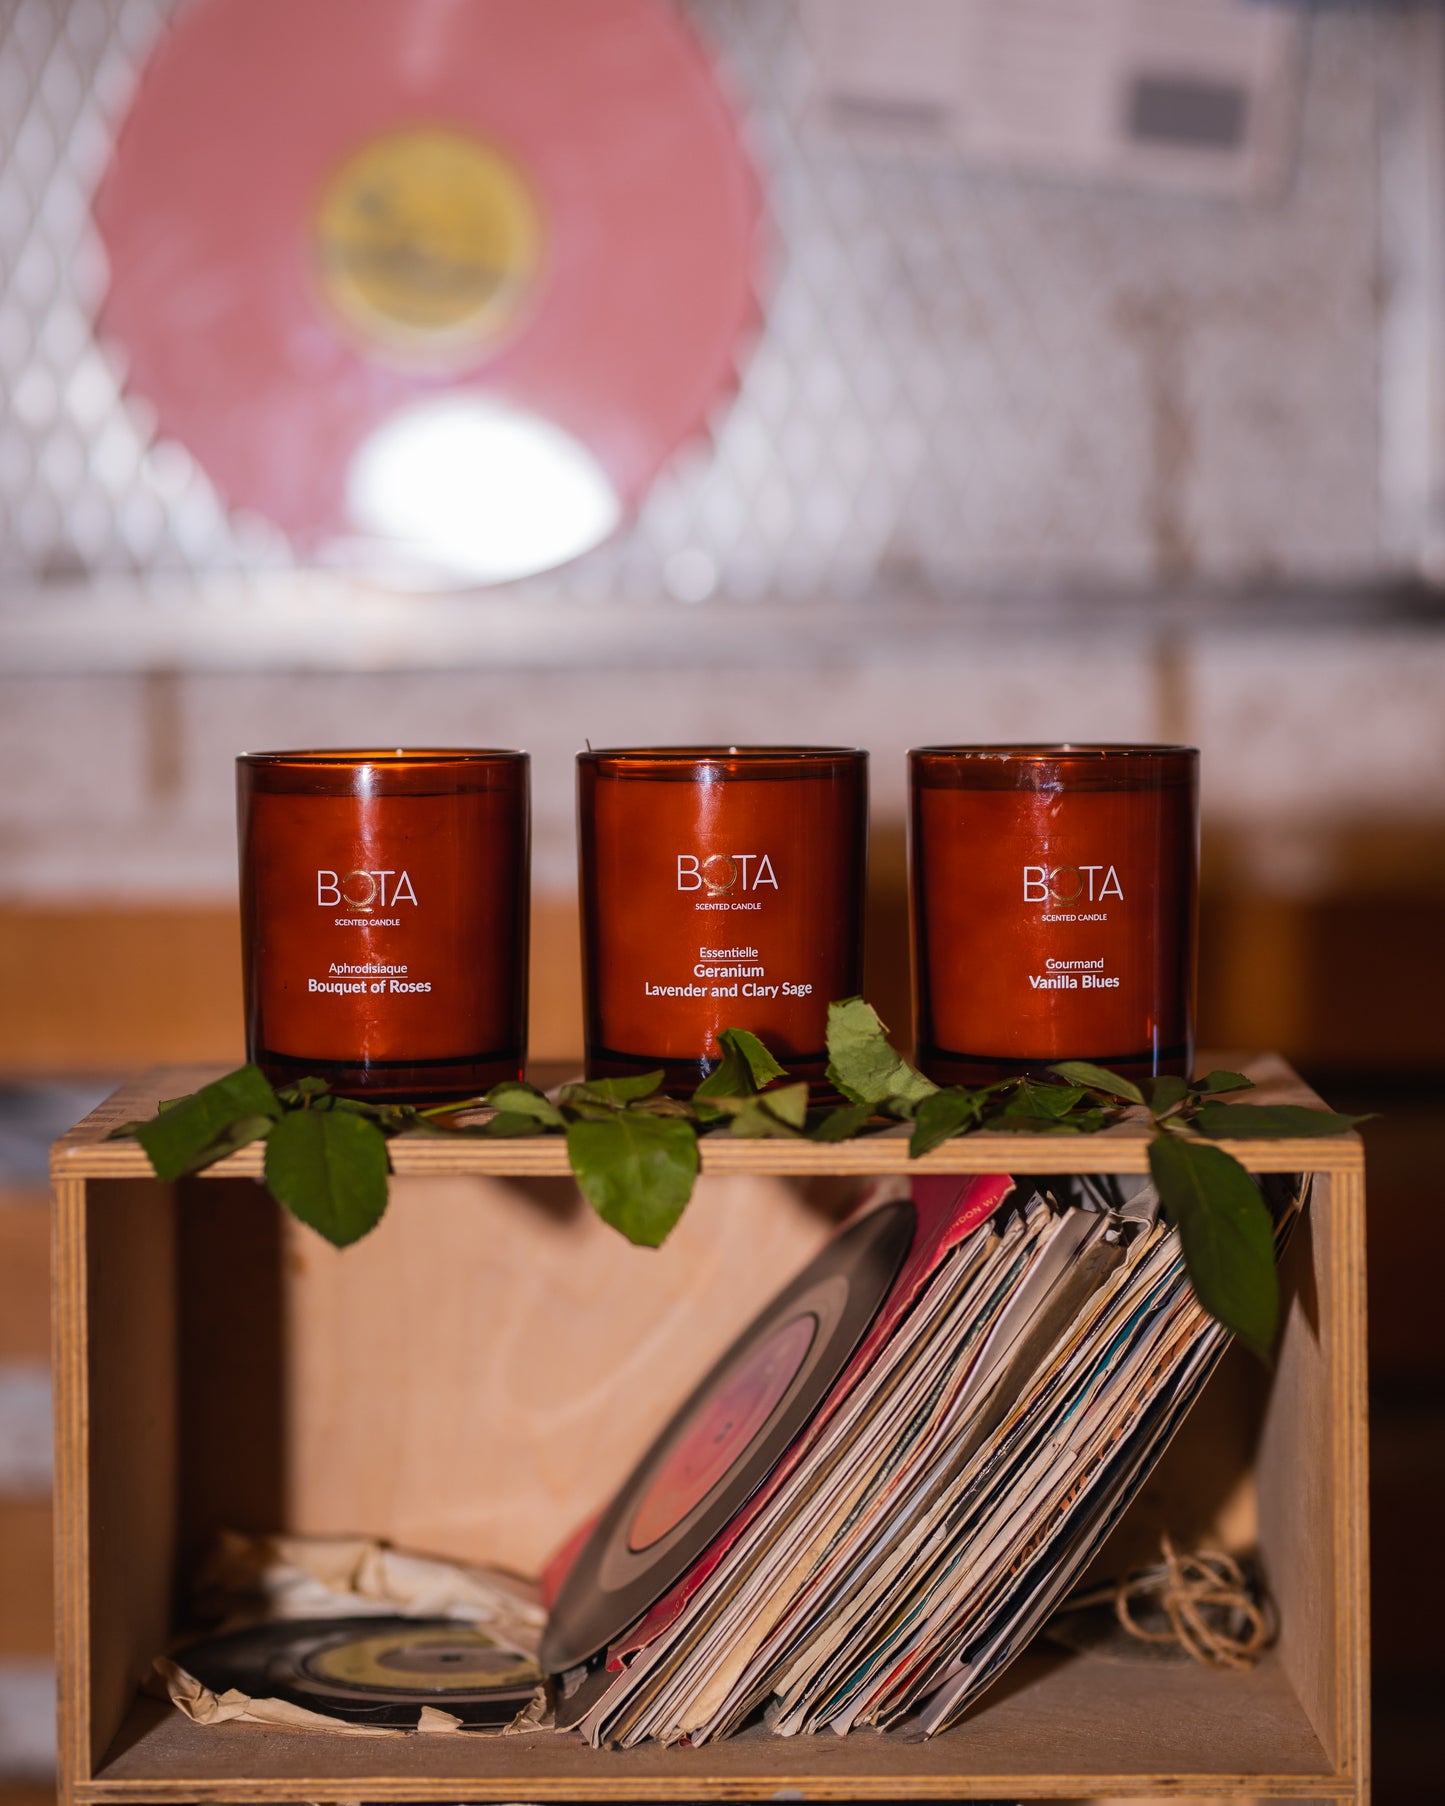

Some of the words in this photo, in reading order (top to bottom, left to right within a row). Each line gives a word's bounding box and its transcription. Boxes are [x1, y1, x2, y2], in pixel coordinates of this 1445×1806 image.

[677, 853, 779, 896] BOTA
[317, 869, 418, 912] BOTA
[1023, 864, 1124, 907] BOTA
[695, 903, 730, 911] SCENTED
[731, 902, 762, 910] CANDLE
[334, 918, 368, 926] SCENTED
[369, 918, 401, 926] CANDLE
[1041, 914, 1077, 922] SCENTED
[1077, 913, 1108, 921] CANDLE
[699, 947, 759, 958] Essentielle
[329, 962, 408, 976] Aphrodisiaque
[1045, 957, 1104, 969] Gourmand
[693, 964, 765, 978] Geranium
[308, 978, 367, 996] Bouquet
[370, 979, 386, 994] of
[389, 979, 432, 993] Roses
[1028, 975, 1078, 989] Vanilla
[1081, 974, 1120, 989] Blues
[644, 982, 708, 997] Lavender
[710, 983, 738, 997] and
[741, 983, 779, 999] Clary
[781, 982, 813, 998] Sage
